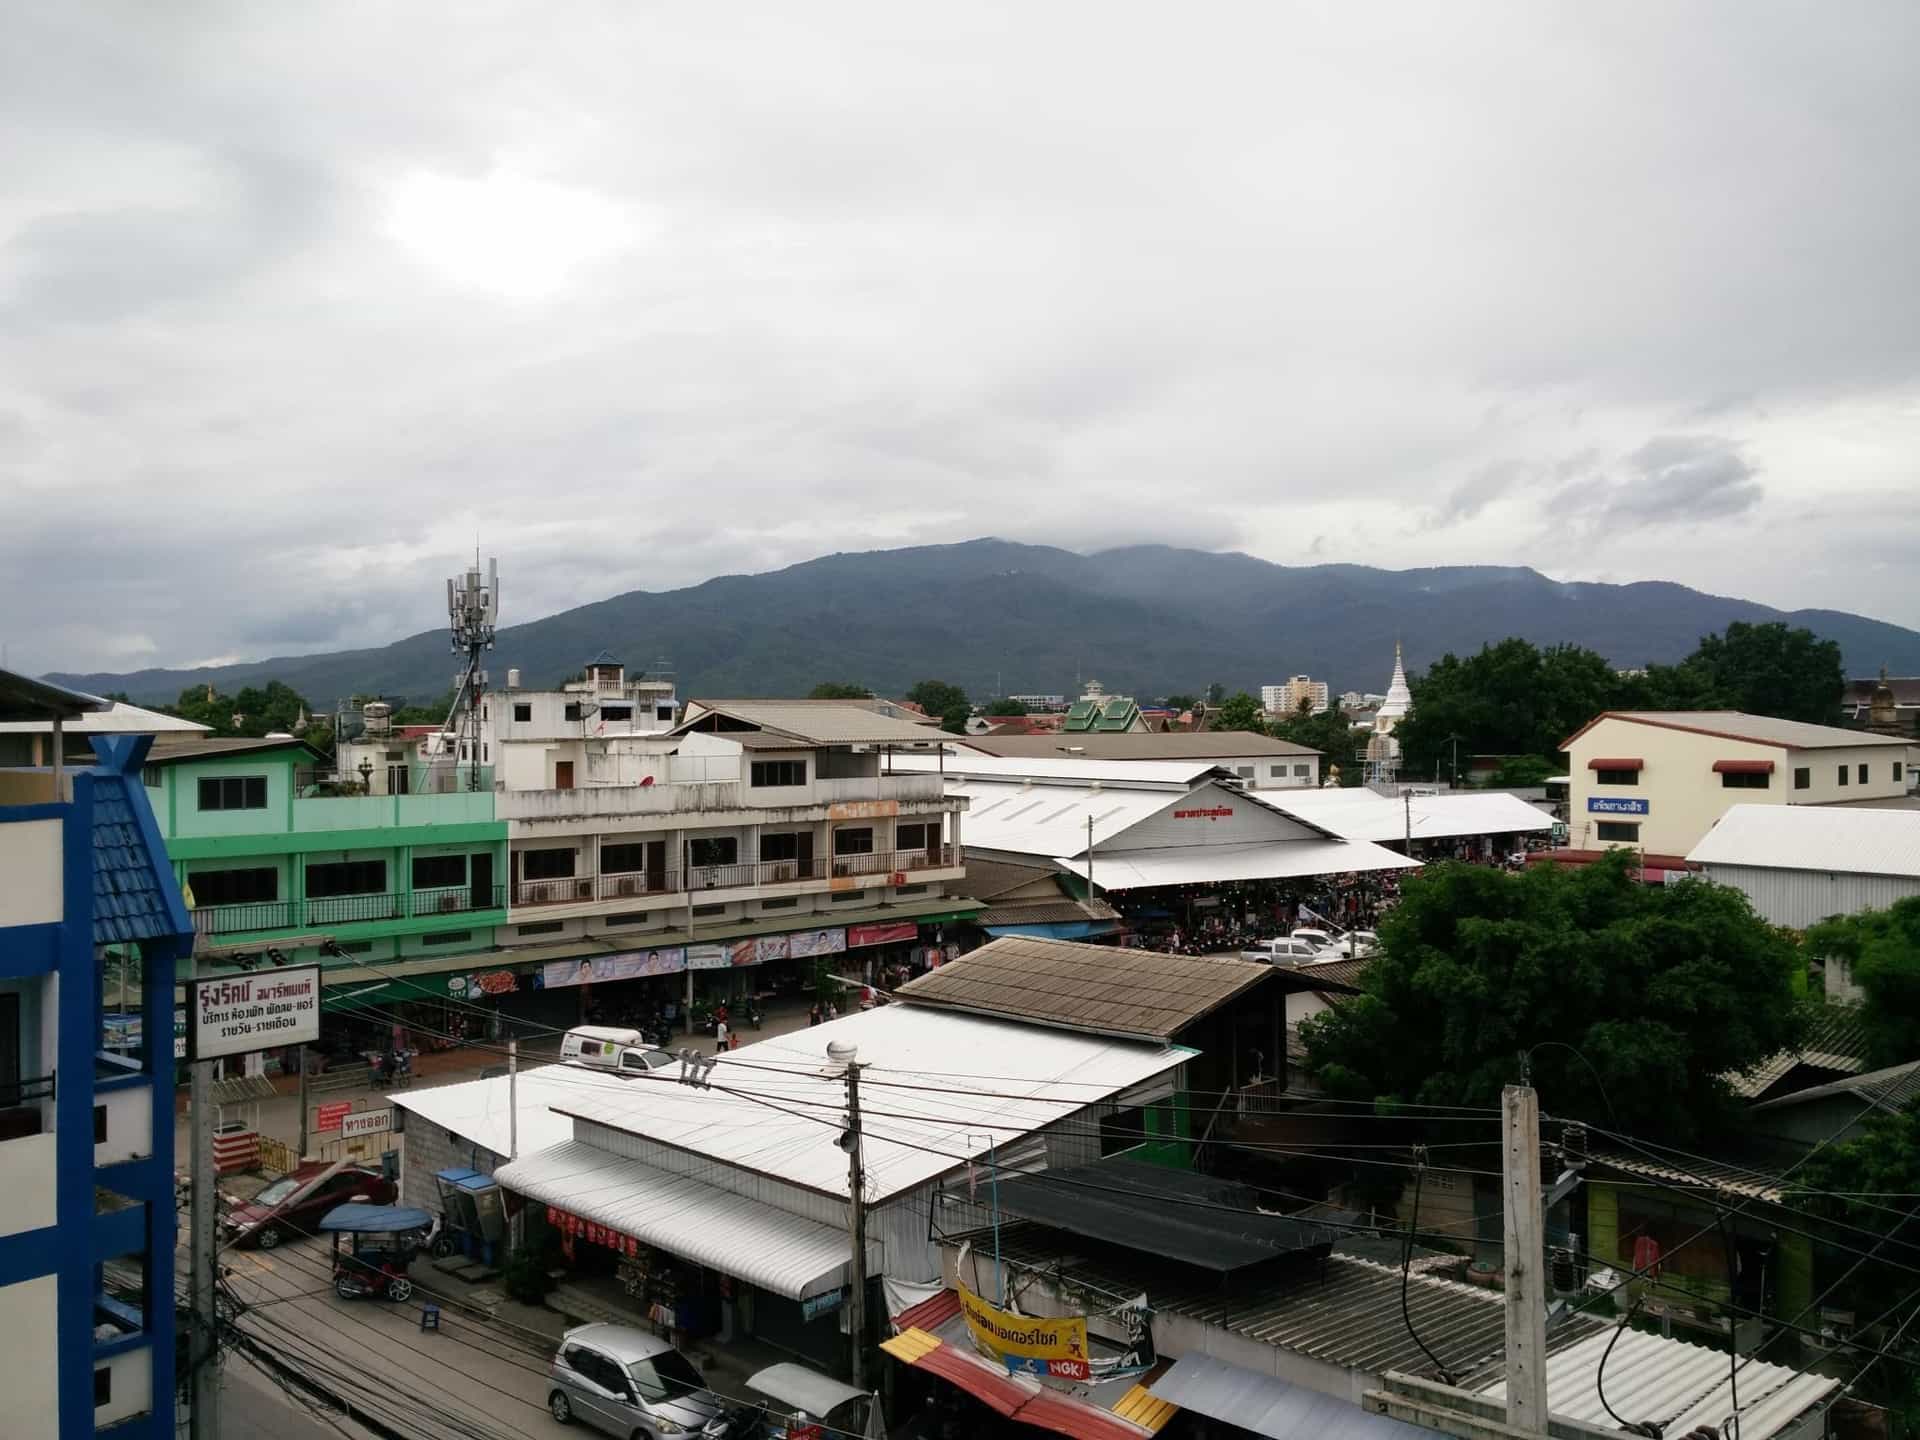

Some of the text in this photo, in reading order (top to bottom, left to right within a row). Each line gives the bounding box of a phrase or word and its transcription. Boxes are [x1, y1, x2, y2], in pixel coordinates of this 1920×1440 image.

[202, 997, 314, 1026] บริการ ห้องพัก พัดลม-แอร์
[221, 1016, 297, 1038] รายวัน-รายเดือน
[346, 1115, 388, 1131] ทางออก
